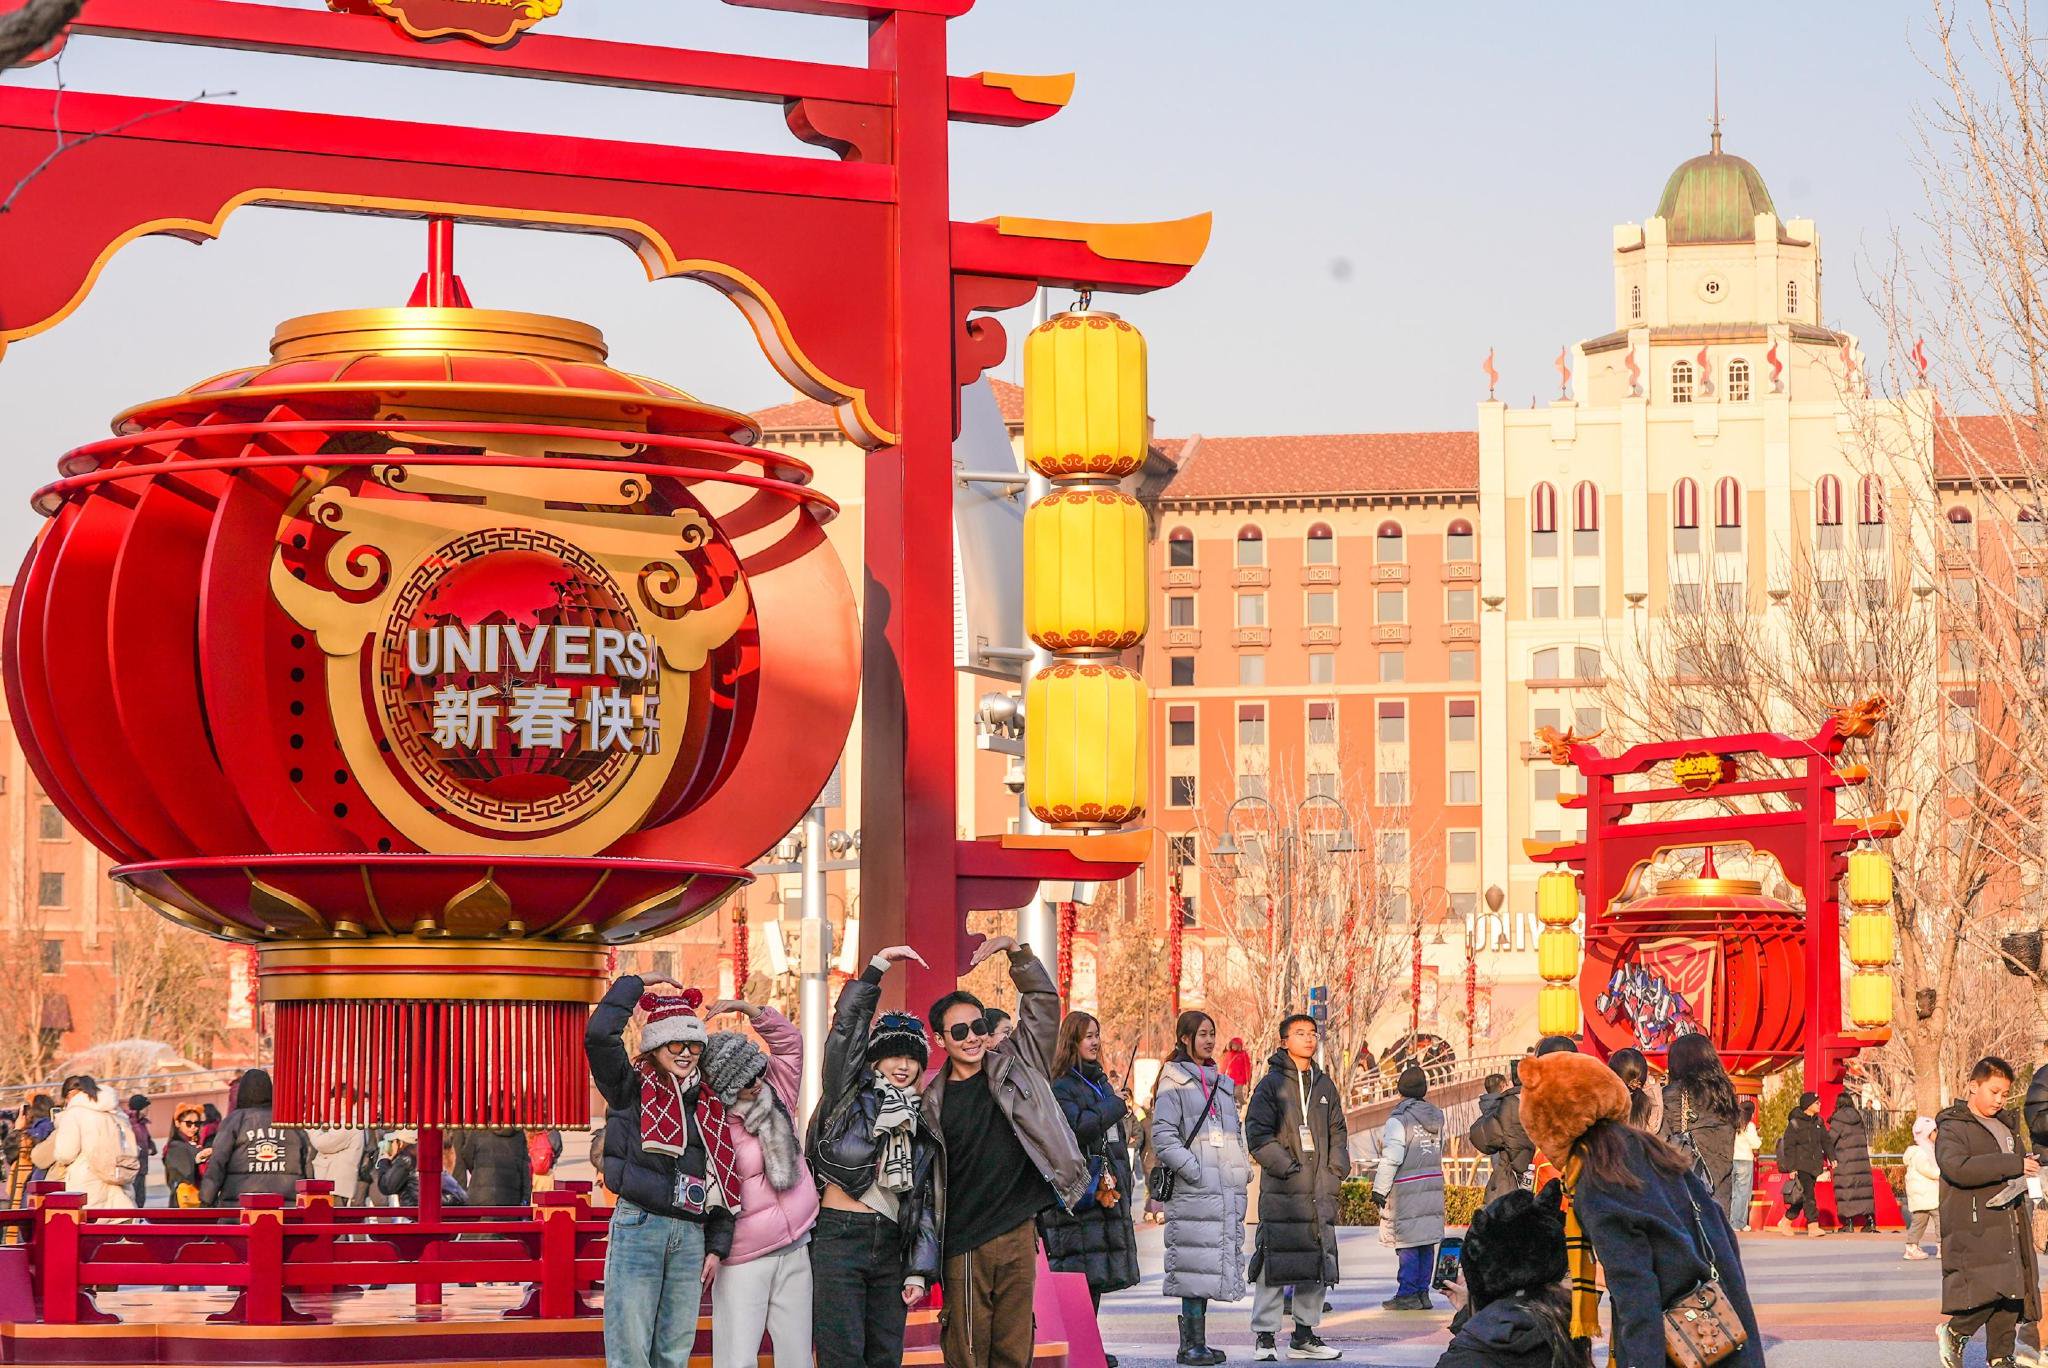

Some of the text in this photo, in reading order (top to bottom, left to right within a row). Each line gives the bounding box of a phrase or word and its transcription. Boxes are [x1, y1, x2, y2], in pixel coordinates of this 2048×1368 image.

[431, 684, 661, 755] 新春快乐
[246, 1127, 286, 1141] PAUL
[248, 1161, 286, 1172] FRANK
